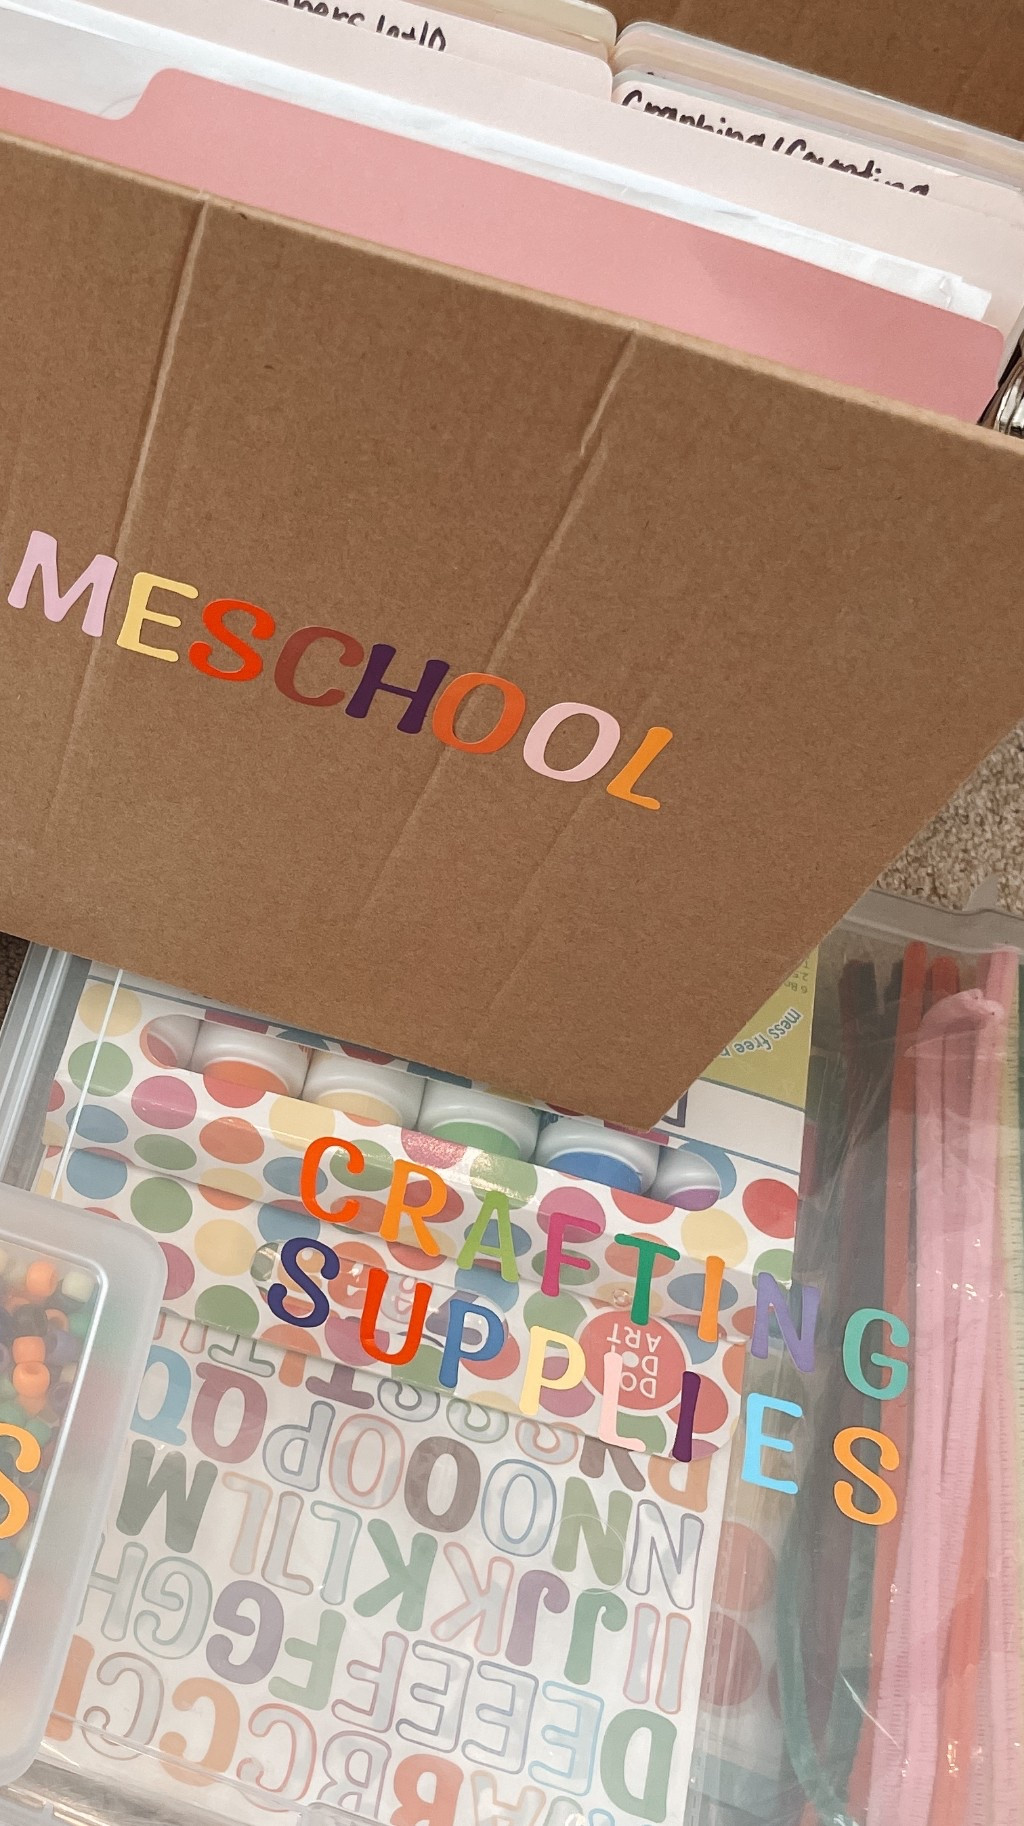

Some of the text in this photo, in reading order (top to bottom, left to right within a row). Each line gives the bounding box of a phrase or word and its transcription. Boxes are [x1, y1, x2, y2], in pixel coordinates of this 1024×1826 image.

[768, 1008, 802, 1040] mess
[734, 1034, 772, 1053] free
[299, 1136, 910, 1400] CRAFTING
[606, 1323, 662, 1353] ART
[267, 1236, 901, 1526] SUPPLIES
[619, 1371, 657, 1399] DO
